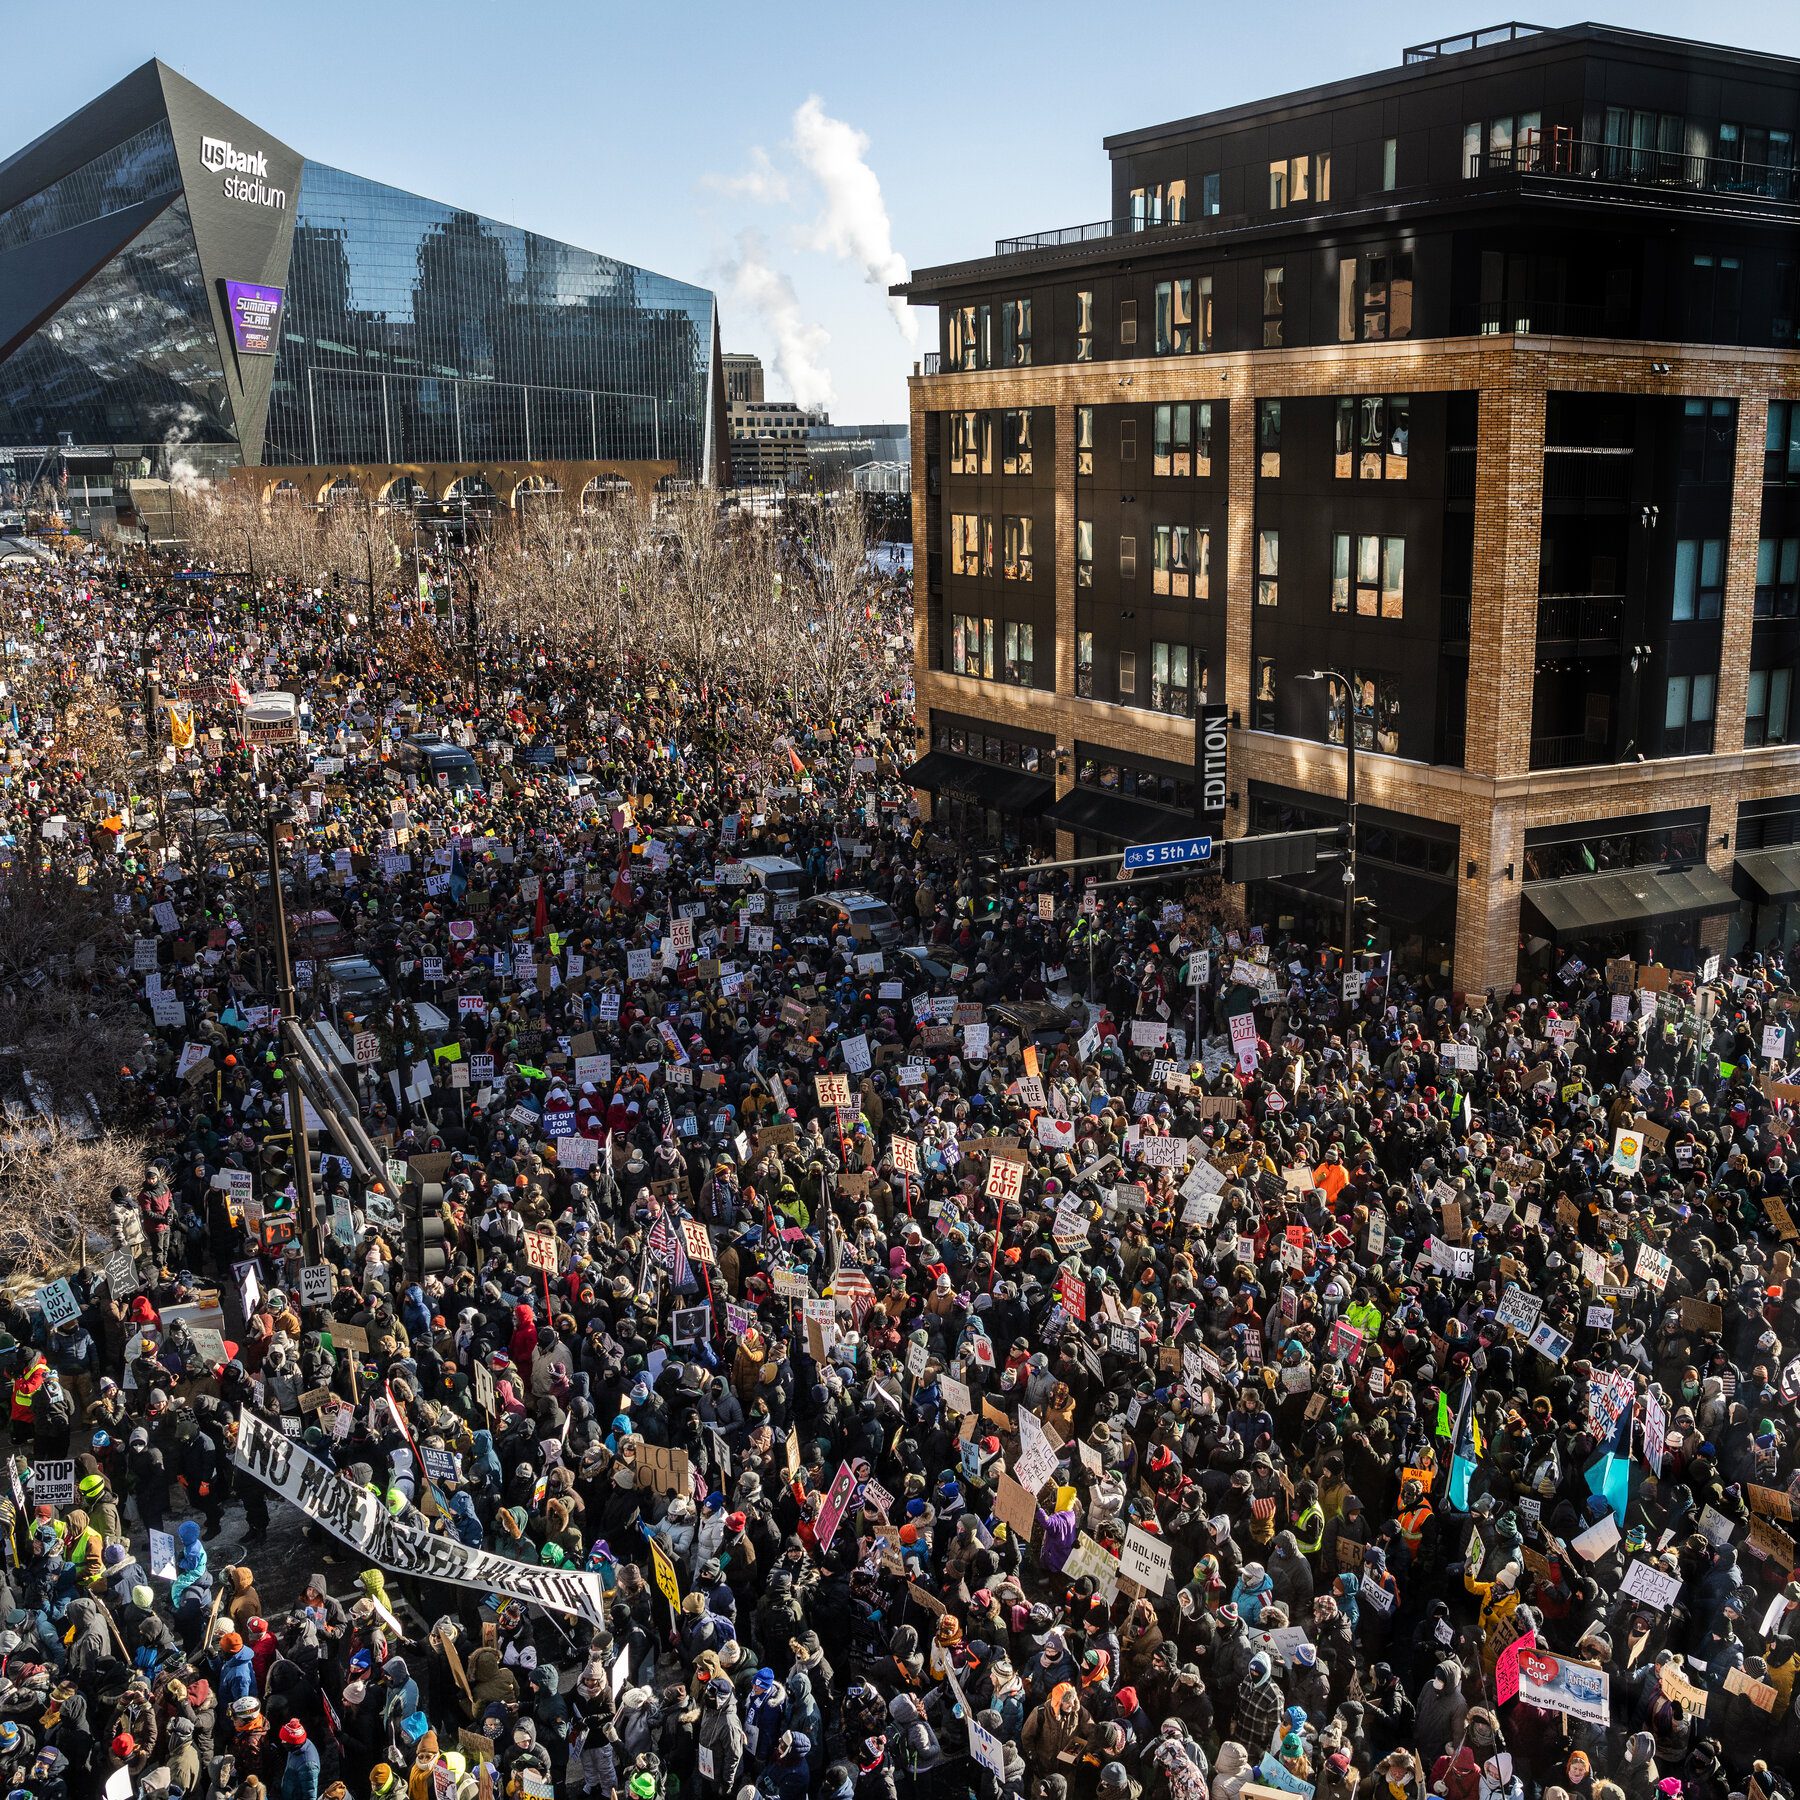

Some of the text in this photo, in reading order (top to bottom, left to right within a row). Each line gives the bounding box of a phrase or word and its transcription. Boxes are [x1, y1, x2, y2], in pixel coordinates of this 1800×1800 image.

[224, 175, 286, 210] stadium
[236, 297, 278, 314] SUMMER
[243, 311, 270, 326] SLAM
[251, 720, 293, 731] KILLER ICE
[251, 730, 261, 740] OFF
[1203, 716, 1227, 811] EDITION
[721, 833, 736, 841] HATE
[1146, 842, 1208, 862] S 5th Av
[429, 876, 444, 886] BYE
[749, 902, 764, 911] OFF
[1039, 900, 1051, 910] ICE
[672, 926, 690, 936] ICE
[673, 936, 691, 945] OUT!
[424, 958, 442, 968] STOP
[1191, 952, 1208, 965] BEGIN
[1192, 963, 1207, 973] ONE
[722, 977, 733, 986] ICE
[1191, 972, 1207, 983] WAY
[1344, 972, 1359, 983] ONE
[1344, 981, 1359, 991] WAY
[459, 997, 484, 1008] GTFO
[1231, 1016, 1252, 1029] ICE
[1549, 1019, 1562, 1028] ICE
[1134, 1033, 1159, 1043] HERE
[1233, 1026, 1255, 1039] OUT!
[1551, 1028, 1574, 1037] NOW!
[357, 1039, 376, 1049] ICE
[849, 1039, 865, 1053] ICE
[1766, 1036, 1778, 1047] MY
[357, 1049, 379, 1060] OUT!
[848, 1050, 870, 1066] OUT OF
[472, 1056, 493, 1067] STOP
[855, 1060, 870, 1072] MN
[909, 1057, 930, 1066] ICE
[1155, 1060, 1177, 1072] ICE
[667, 1064, 692, 1074] ARREST
[669, 1072, 691, 1084] ICE
[820, 1083, 844, 1094] ICE
[821, 1093, 847, 1104] OUT!
[1027, 1093, 1041, 1103] ICE
[515, 1108, 537, 1122] ICE OUT
[544, 1111, 575, 1122] ICE OUT
[552, 1120, 568, 1128] FOR
[686, 1117, 697, 1127] ICE
[550, 1126, 572, 1136] GOOD
[687, 1126, 697, 1135] OUT
[1042, 1132, 1055, 1140] ALL
[561, 1138, 597, 1148] ICE AGENTS
[1145, 1137, 1180, 1149] BRING
[559, 1151, 597, 1162] SENTENCED
[894, 1143, 914, 1161] ICE
[943, 1144, 956, 1158] ICE
[895, 1156, 916, 1171] OUT!
[946, 1152, 960, 1166] OUT
[1145, 1155, 1186, 1166] HOME!
[230, 1173, 243, 1181] THAT'S
[992, 1165, 1018, 1185] ICE
[989, 1180, 1018, 1199] OUT!
[942, 1199, 958, 1218] ICE
[280, 1223, 292, 1238] 15
[684, 1226, 707, 1246] ICE
[1288, 1229, 1300, 1237] ICE
[1063, 1233, 1086, 1242] HUMAN
[528, 1235, 553, 1258] ICE
[689, 1242, 711, 1260] OUT!
[1643, 1245, 1661, 1260] NO
[531, 1251, 557, 1272] OUT!
[304, 1267, 327, 1279] ONE
[304, 1278, 327, 1290] WAY
[774, 1284, 790, 1295] NAZI
[42, 1283, 61, 1299] ICE
[1602, 1287, 1634, 1296] RESIST
[46, 1293, 66, 1310] OUT
[820, 1300, 830, 1309] WE
[1502, 1292, 1541, 1315] NAZIS DON'T
[49, 1302, 75, 1322] NOW
[803, 1308, 816, 1317] TIME
[1509, 1304, 1526, 1317] WELL
[1500, 1311, 1532, 1332] THE COLD
[195, 1331, 217, 1340] Jesus
[1110, 1326, 1127, 1342] ICE
[1245, 1330, 1260, 1346] ICE
[199, 1342, 219, 1352] Wept
[912, 1354, 923, 1363] OUT
[910, 1361, 924, 1375] NOW
[282, 1416, 300, 1428] ABOLISH
[284, 1428, 300, 1438] ICE
[247, 1418, 294, 1487] NO
[427, 1450, 448, 1462] HATE
[1042, 1443, 1057, 1469] ICE
[640, 1445, 688, 1473] ICE
[35, 1461, 73, 1482] STOP
[429, 1469, 455, 1481] ICE OUT
[1023, 1463, 1035, 1483] LIKE
[1031, 1460, 1046, 1485] SMELL
[1410, 1469, 1423, 1478] OUR
[638, 1465, 684, 1495] OUT
[35, 1483, 73, 1493] ICE TERROR
[869, 1478, 896, 1503] ABOLISH
[34, 1491, 73, 1500] NOW!
[300, 1464, 370, 1542] MORE
[363, 1508, 478, 1580] MASKED
[1077, 1534, 1119, 1571] KINDNES
[1126, 1538, 1167, 1569] ABOLISH
[1081, 1553, 1115, 1584] IS NOT
[1135, 1560, 1151, 1577] ICE
[1633, 1565, 1671, 1588] RESIST
[1375, 1588, 1391, 1606] OUT
[1630, 1581, 1670, 1607] FACISM
[1528, 1656, 1546, 1670] Pro
[1526, 1667, 1549, 1682] Cold
[1519, 1691, 1541, 1703] Hands
[1557, 1703, 1570, 1711] our
[974, 1723, 992, 1745] MN
[975, 1751, 1001, 1779] NICE
